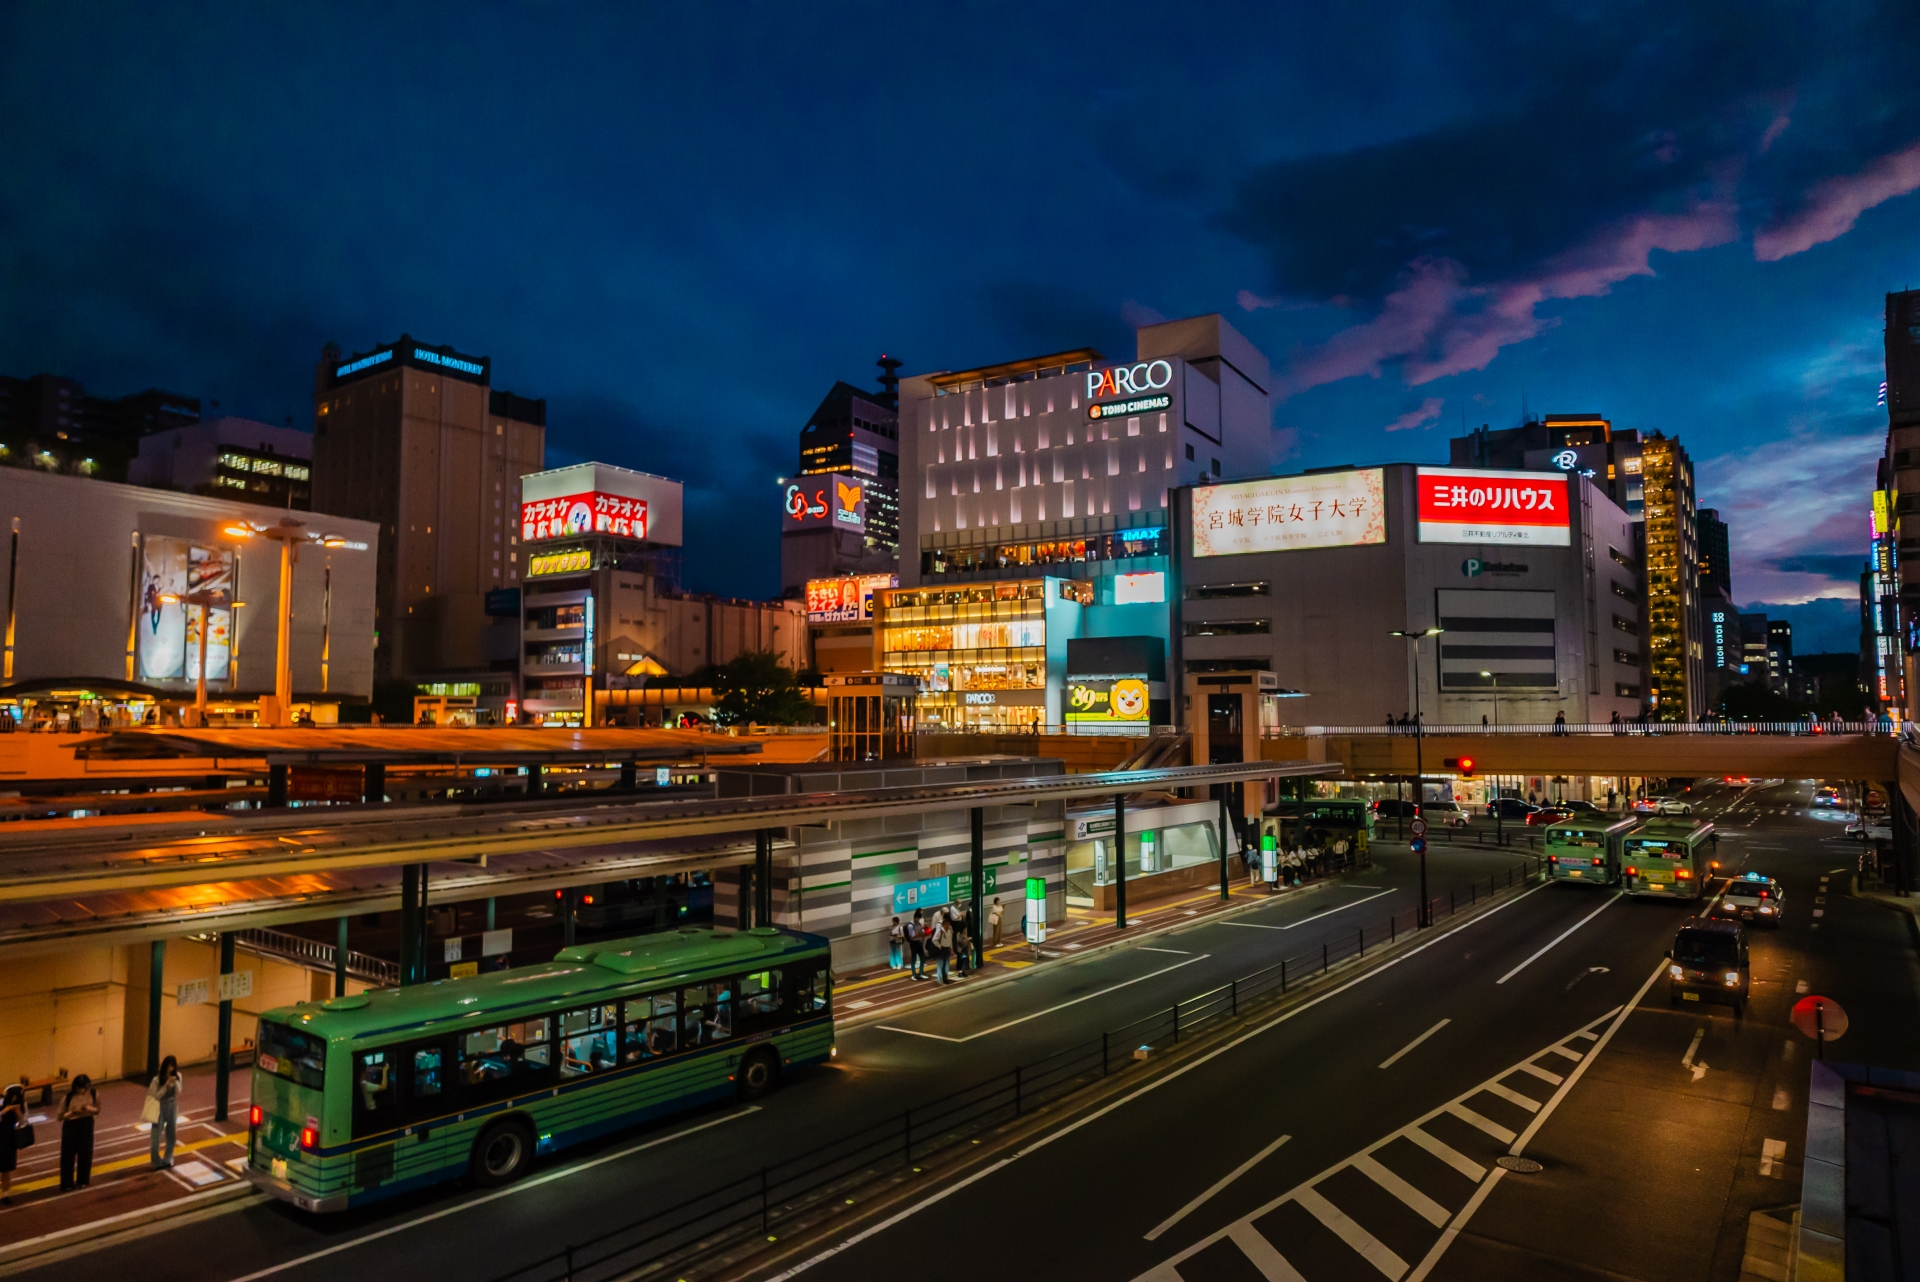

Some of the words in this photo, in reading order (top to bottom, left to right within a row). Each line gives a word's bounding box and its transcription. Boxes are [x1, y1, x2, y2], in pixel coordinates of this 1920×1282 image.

[414, 348, 441, 365] HOTEL
[441, 356, 483, 375] MONTEREY
[1086, 360, 1173, 399] PARCO
[1102, 404, 1126, 416] TOHO
[1127, 396, 1169, 412] CINEMAS
[595, 495, 647, 519] カラオケ
[1433, 485, 1555, 511] 三井のリハウス
[523, 499, 571, 523] カラオケ
[1208, 497, 1368, 530] 宮城学院女子大学
[1123, 529, 1160, 541] IMAX
[1467, 559, 1479, 577] P
[1880, 552, 1888, 571] RIZAP
[808, 588, 839, 600] 大きい
[808, 599, 839, 611] サイズ
[1413, 822, 1424, 831] 40
